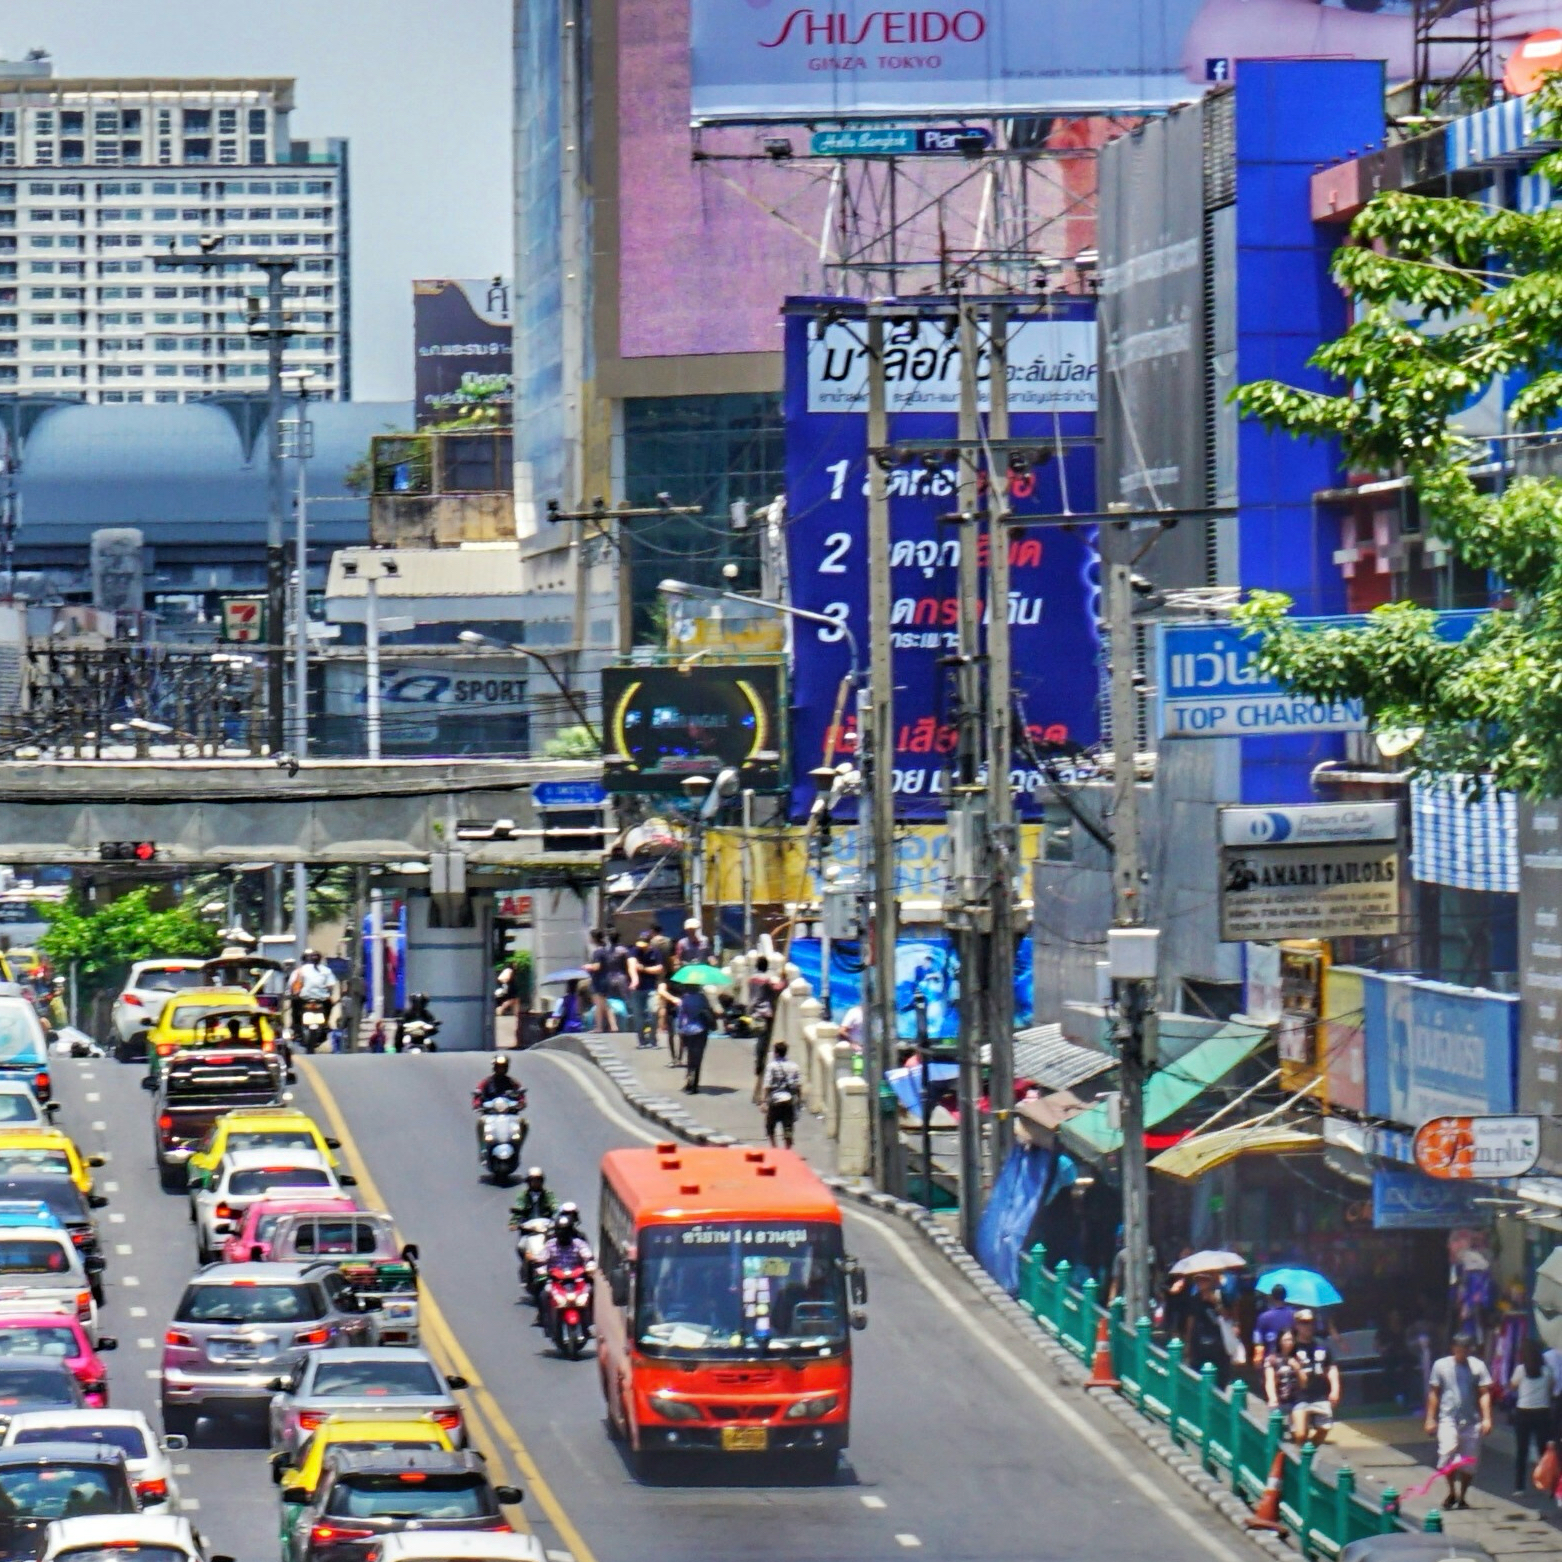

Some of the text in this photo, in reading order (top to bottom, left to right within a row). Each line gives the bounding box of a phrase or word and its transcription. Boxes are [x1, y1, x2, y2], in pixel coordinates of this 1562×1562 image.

[757, 9, 985, 48] SHISEIDO
[808, 56, 942, 70] GINZA TOKYO
[825, 459, 849, 500] 1
[818, 532, 852, 573] 2
[818, 602, 849, 642] 3
[455, 680, 528, 702] SPORT
[1174, 701, 1362, 731] TOP CHAROEN
[1262, 861, 1395, 886] AMARI TAILORS
[735, 1229, 752, 1243] 14
